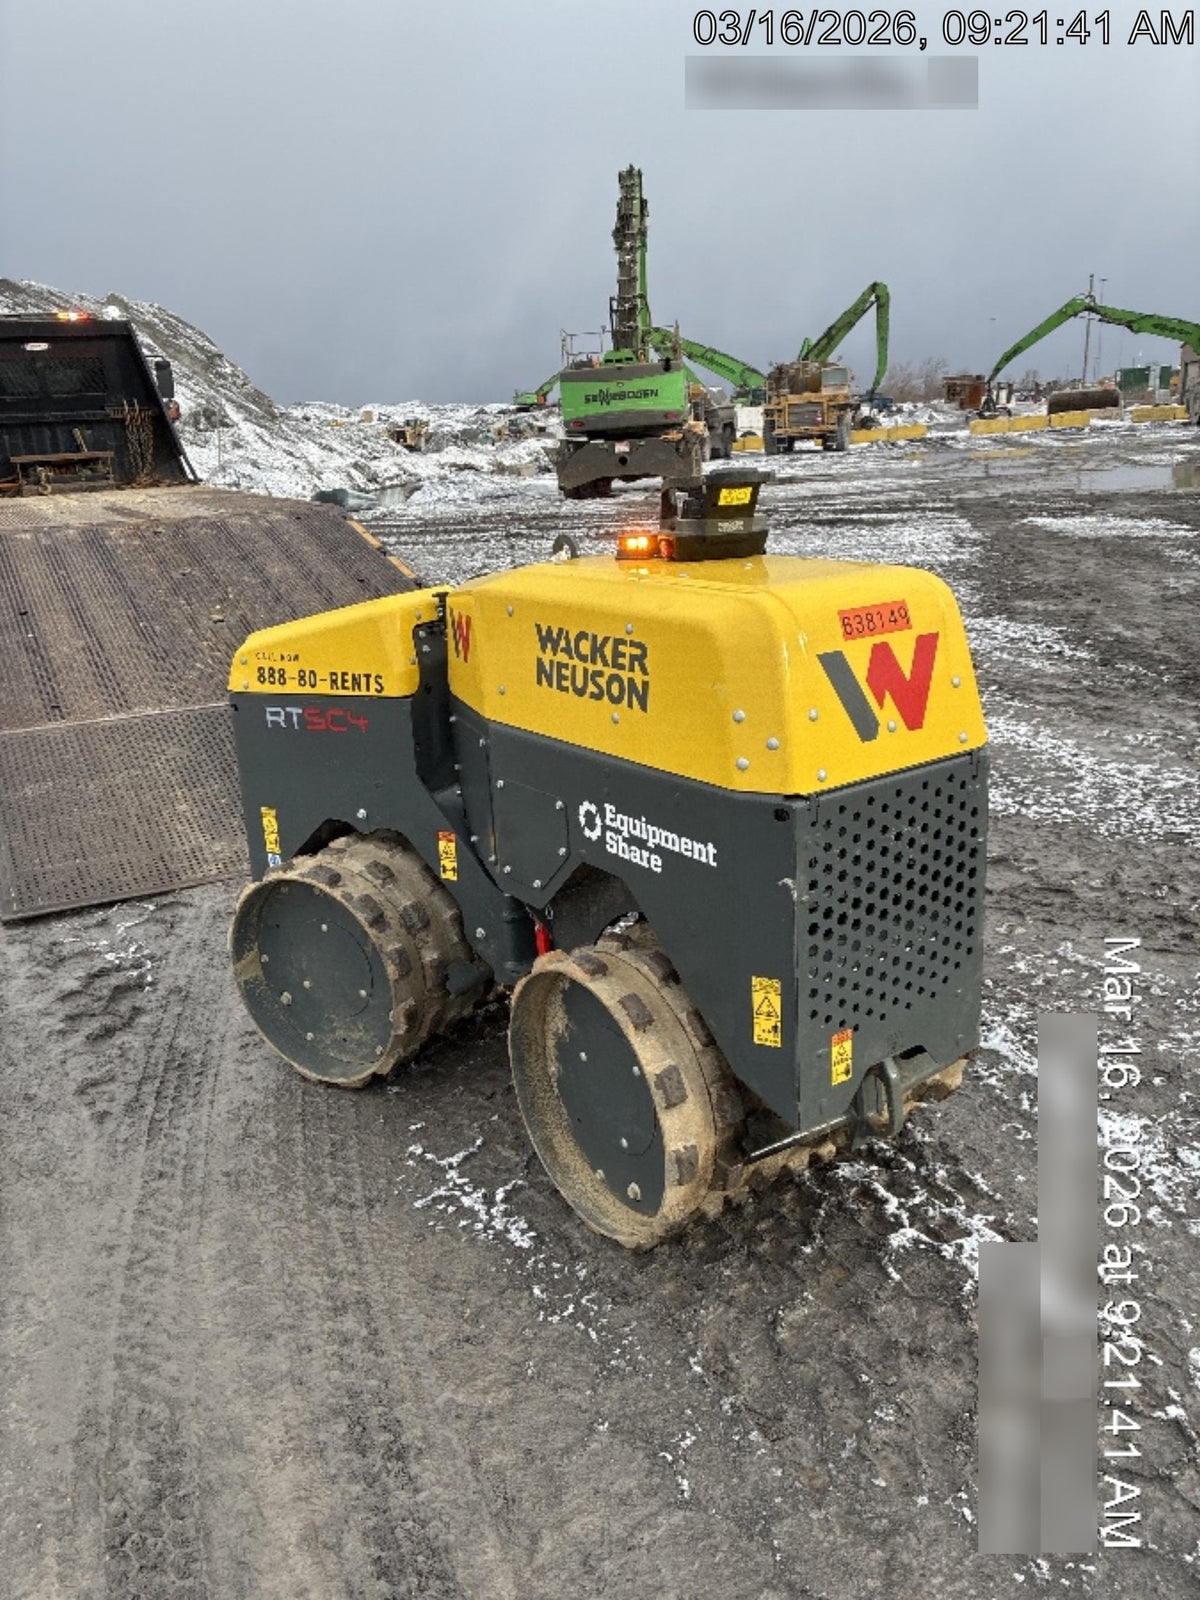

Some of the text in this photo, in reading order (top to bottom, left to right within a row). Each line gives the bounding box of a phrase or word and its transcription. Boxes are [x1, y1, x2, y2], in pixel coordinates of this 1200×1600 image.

[584, 387, 659, 406] SENNEBOGEN
[842, 604, 911, 637] 638149
[280, 653, 300, 663] NOW
[535, 622, 649, 676] WACKER
[256, 666, 385, 694] 888-80-RENTS
[536, 655, 649, 713] NEUSON
[603, 802, 718, 868] Equipment
[605, 829, 663, 874] Share
